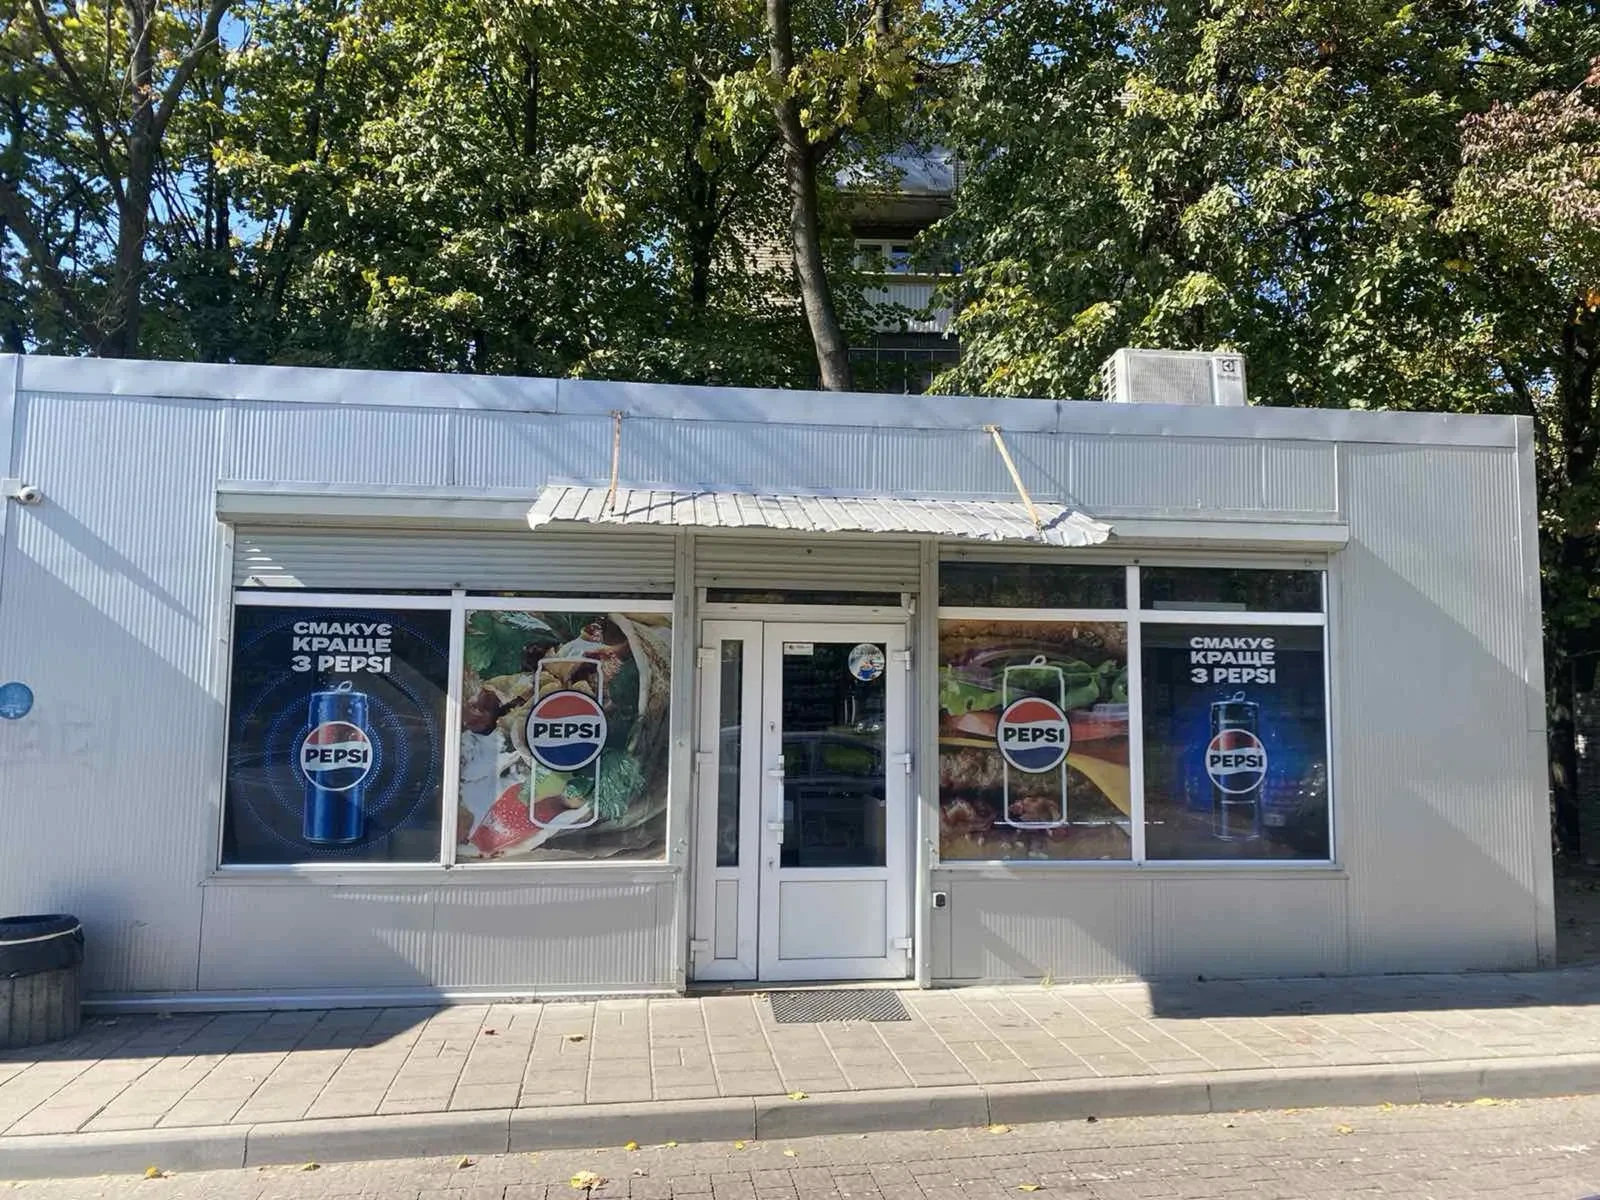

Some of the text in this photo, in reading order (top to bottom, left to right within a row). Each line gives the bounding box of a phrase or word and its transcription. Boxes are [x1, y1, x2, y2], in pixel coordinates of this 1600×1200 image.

[293, 621, 392, 636] СМАКУЄ
[292, 637, 392, 655] КРАЩЕ
[1190, 637, 1275, 649] СМАКУЄ
[291, 655, 391, 673] З PEPSI
[1190, 651, 1275, 667] КРАЩЕ
[1191, 667, 1276, 684] З PEPSI
[533, 723, 601, 739] PEPSI
[1003, 727, 1065, 743] PEPSI
[305, 748, 369, 763] PEPSI
[1209, 754, 1264, 768] PEPSI
